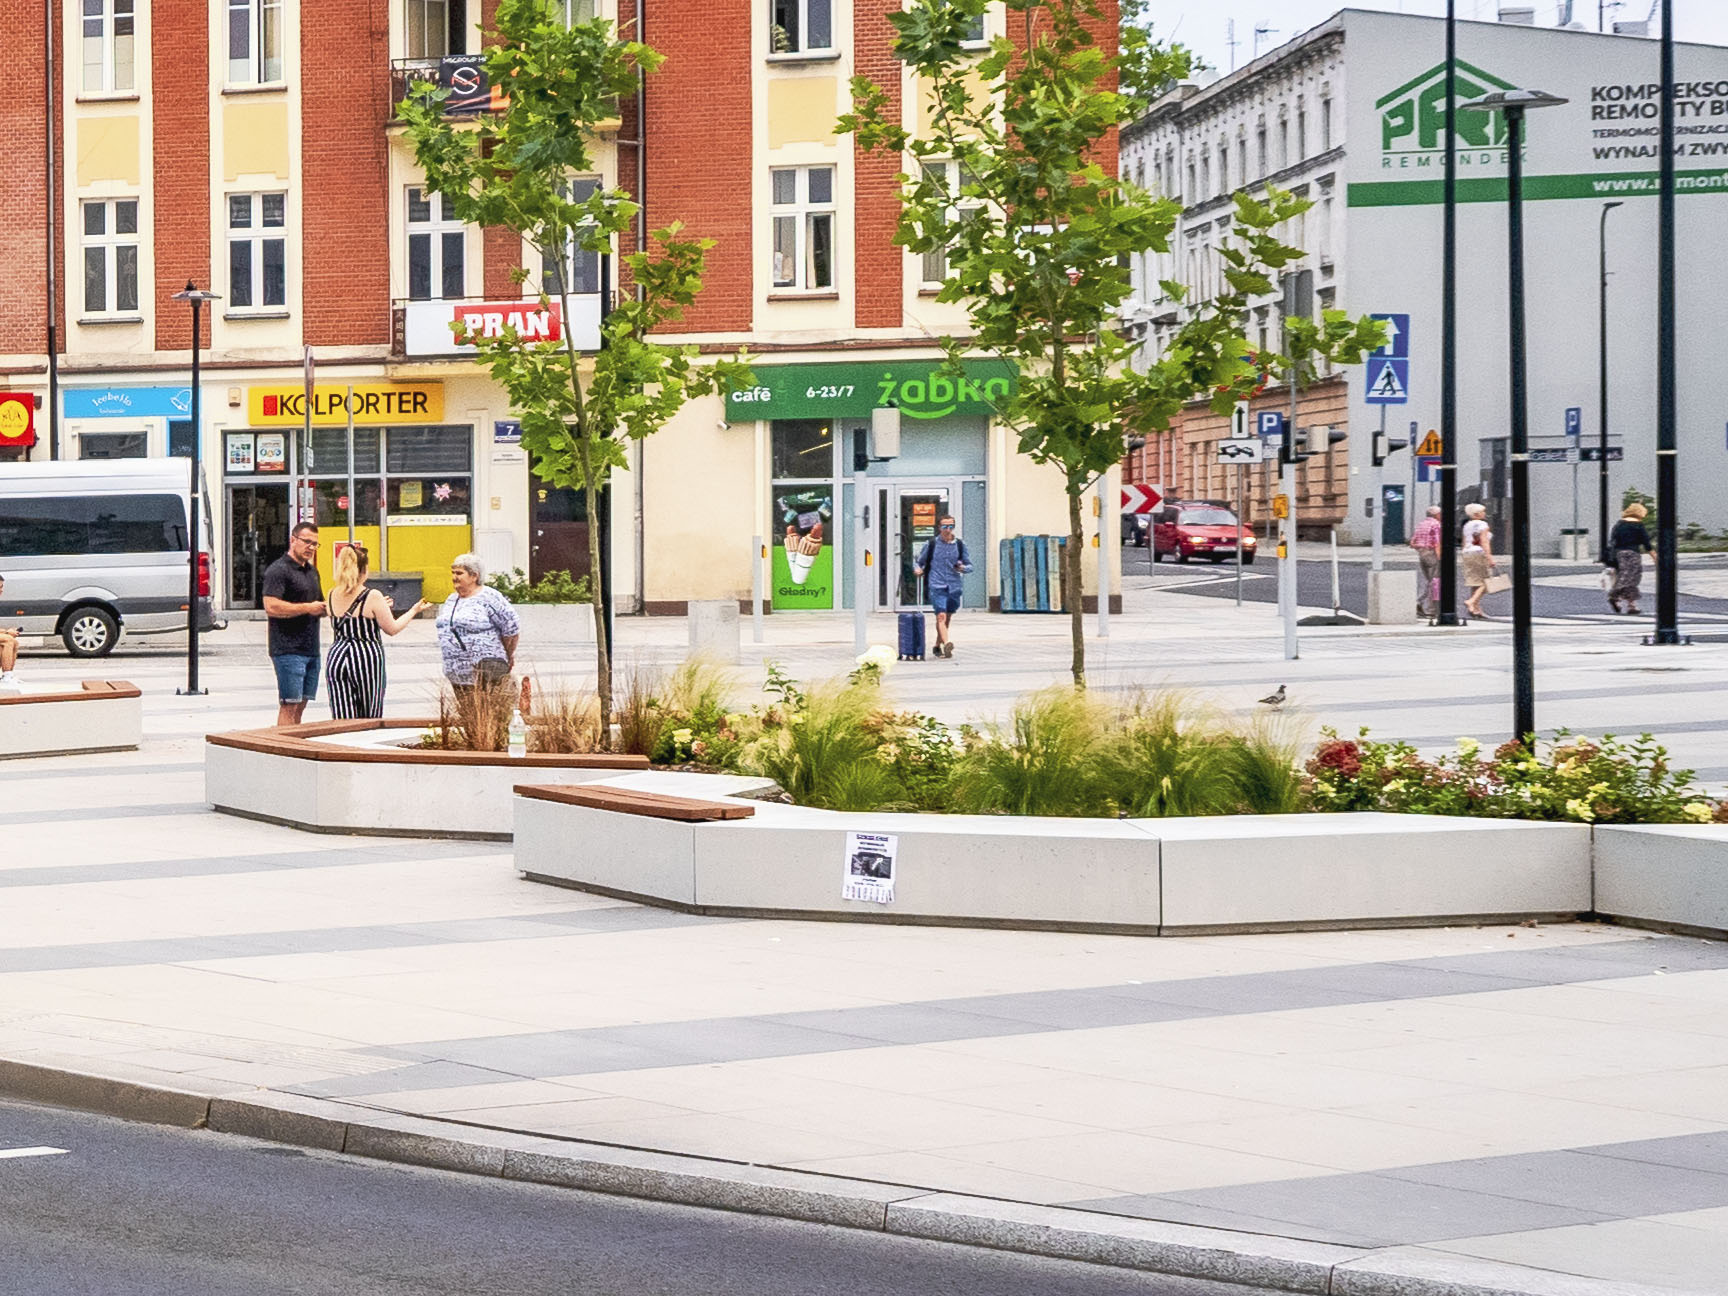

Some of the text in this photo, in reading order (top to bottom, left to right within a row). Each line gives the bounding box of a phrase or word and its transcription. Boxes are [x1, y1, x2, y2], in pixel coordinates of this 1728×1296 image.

[1591, 80, 1728, 102] KOMPEKSO
[1591, 100, 1728, 120] REMOTY B
[1592, 144, 1686, 159] WYNAJM
[806, 385, 855, 398] 6-23/7
[876, 372, 1010, 405] żabka
[279, 391, 429, 417] KOLPORTER
[506, 425, 515, 436] 7
[1262, 414, 1278, 432] P
